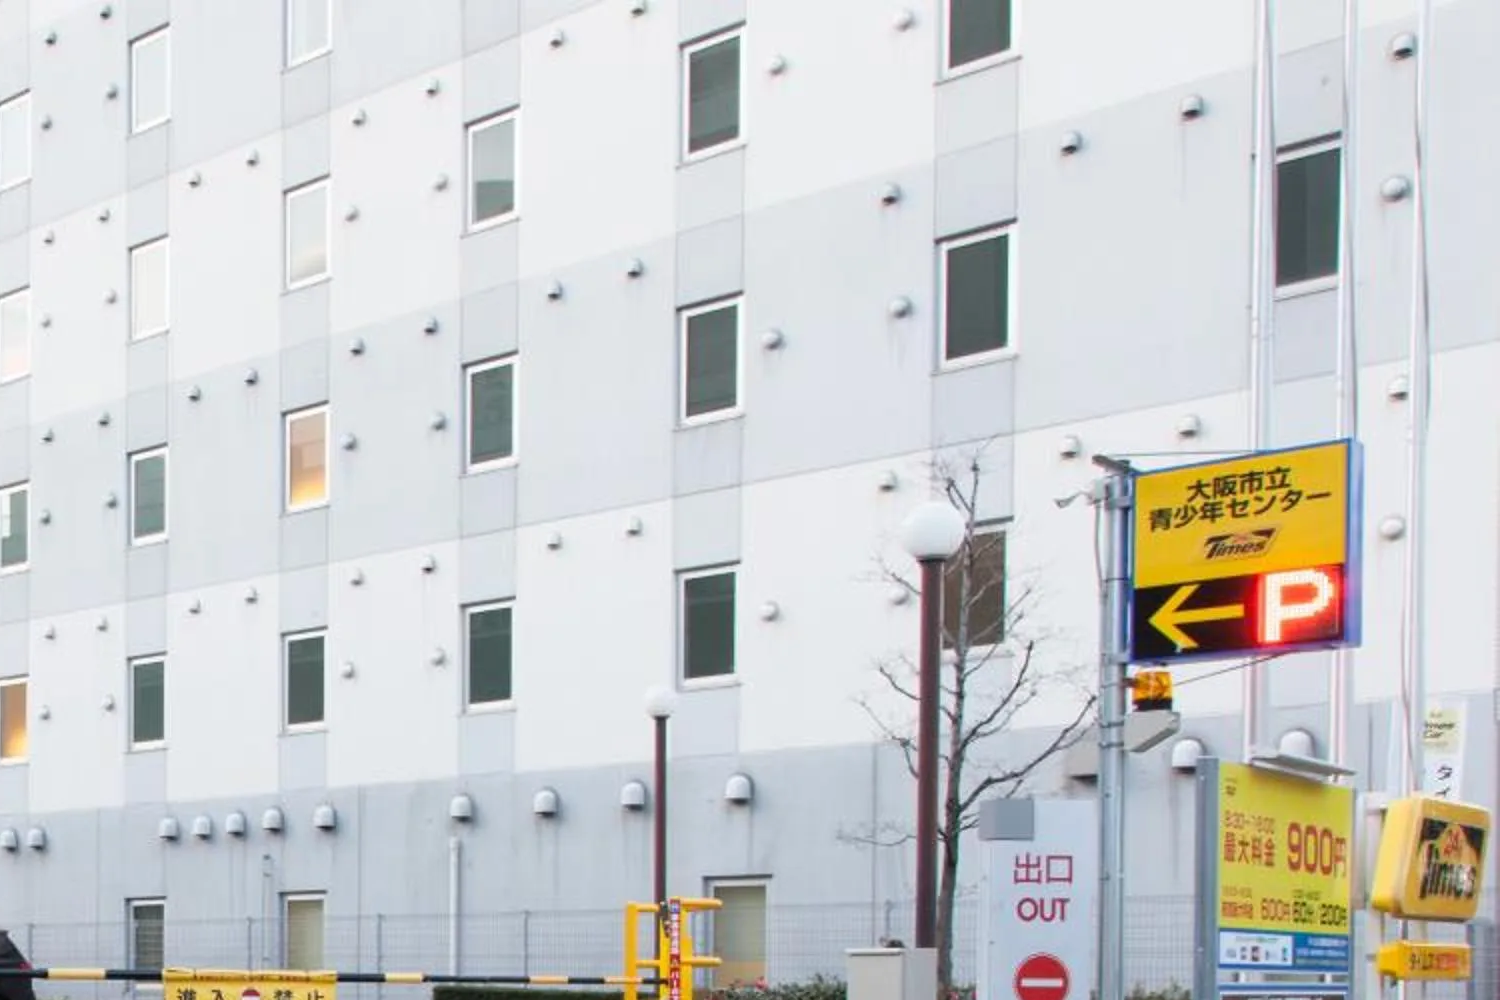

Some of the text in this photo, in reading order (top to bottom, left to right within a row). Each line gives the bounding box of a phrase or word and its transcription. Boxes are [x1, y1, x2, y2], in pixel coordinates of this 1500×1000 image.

[1187, 466, 1291, 503] 大阪市立
[1148, 489, 1332, 533] 青少年センター
[1204, 527, 1277, 559] Times
[1261, 568, 1336, 643] P
[1013, 852, 1073, 884] 出口
[1287, 821, 1347, 878] 900円
[1017, 897, 1070, 922] OUT
